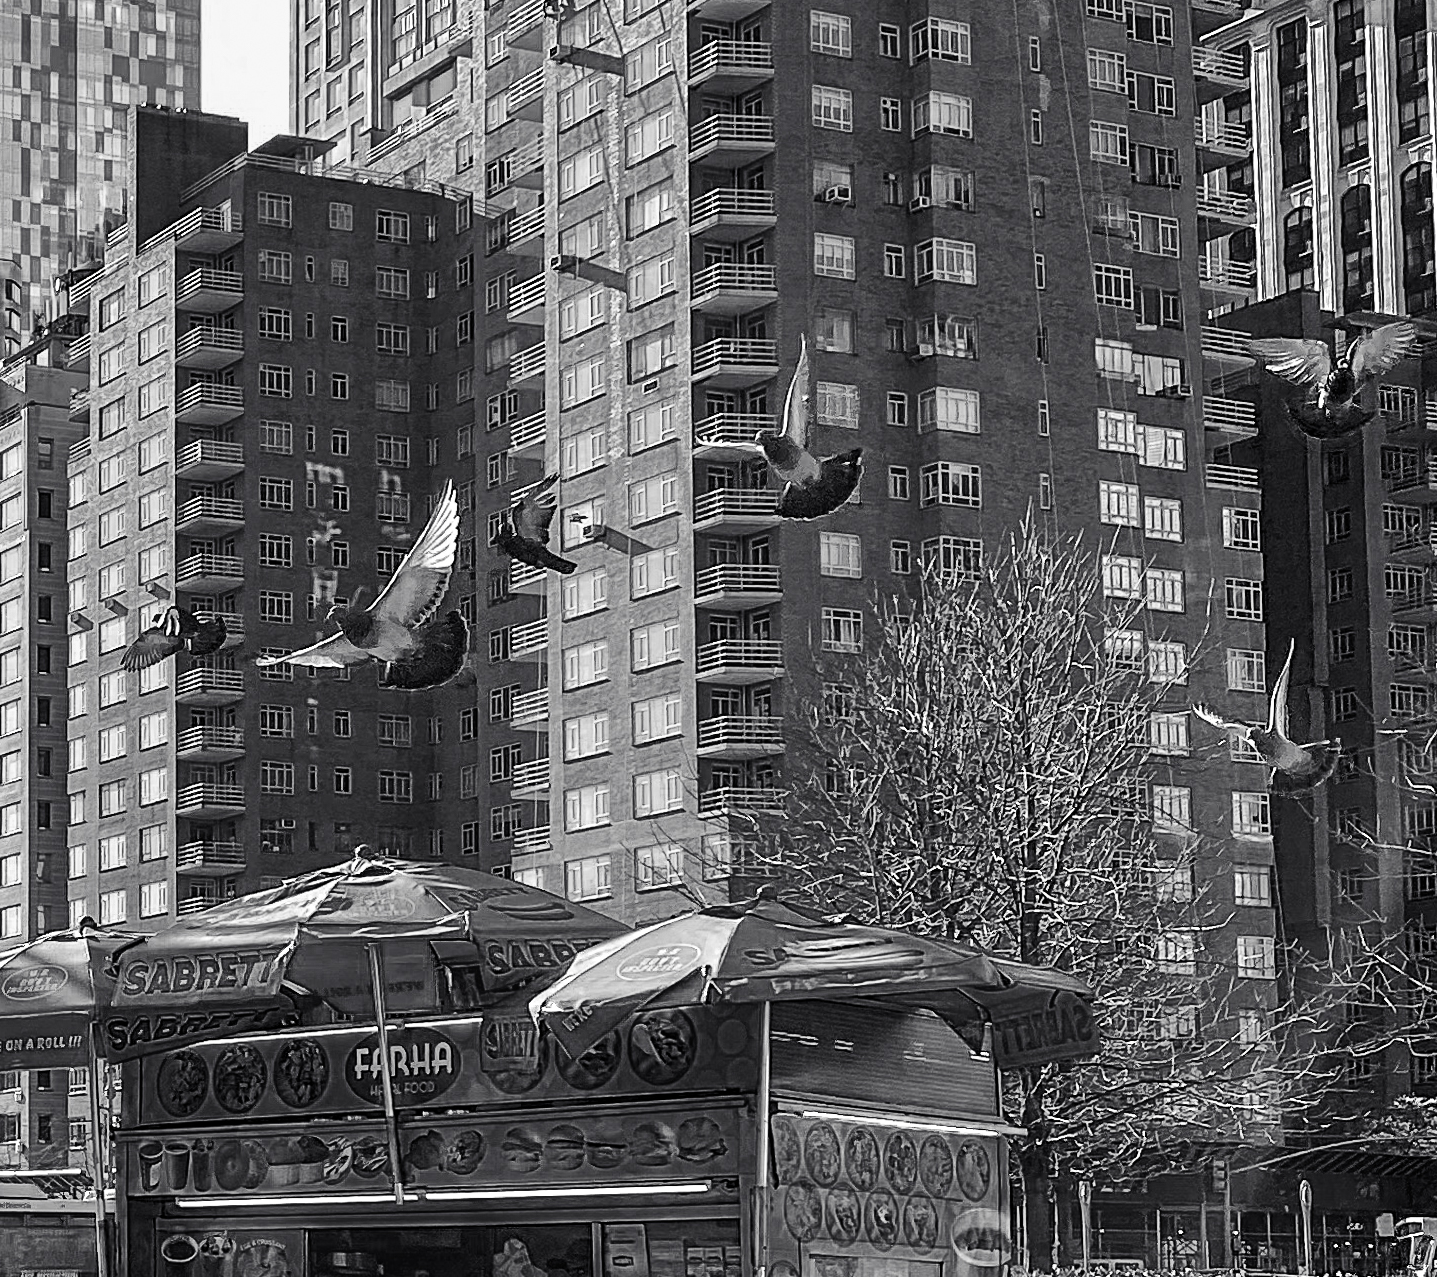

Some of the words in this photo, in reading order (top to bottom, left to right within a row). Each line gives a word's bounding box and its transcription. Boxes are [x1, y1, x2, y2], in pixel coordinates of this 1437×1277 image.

[5, 1038, 23, 1052] ON
[25, 1038, 34, 1050] A
[37, 1036, 66, 1051] ROLL
[354, 1041, 453, 1080] FARHA
[404, 1080, 435, 1094] FOOD
